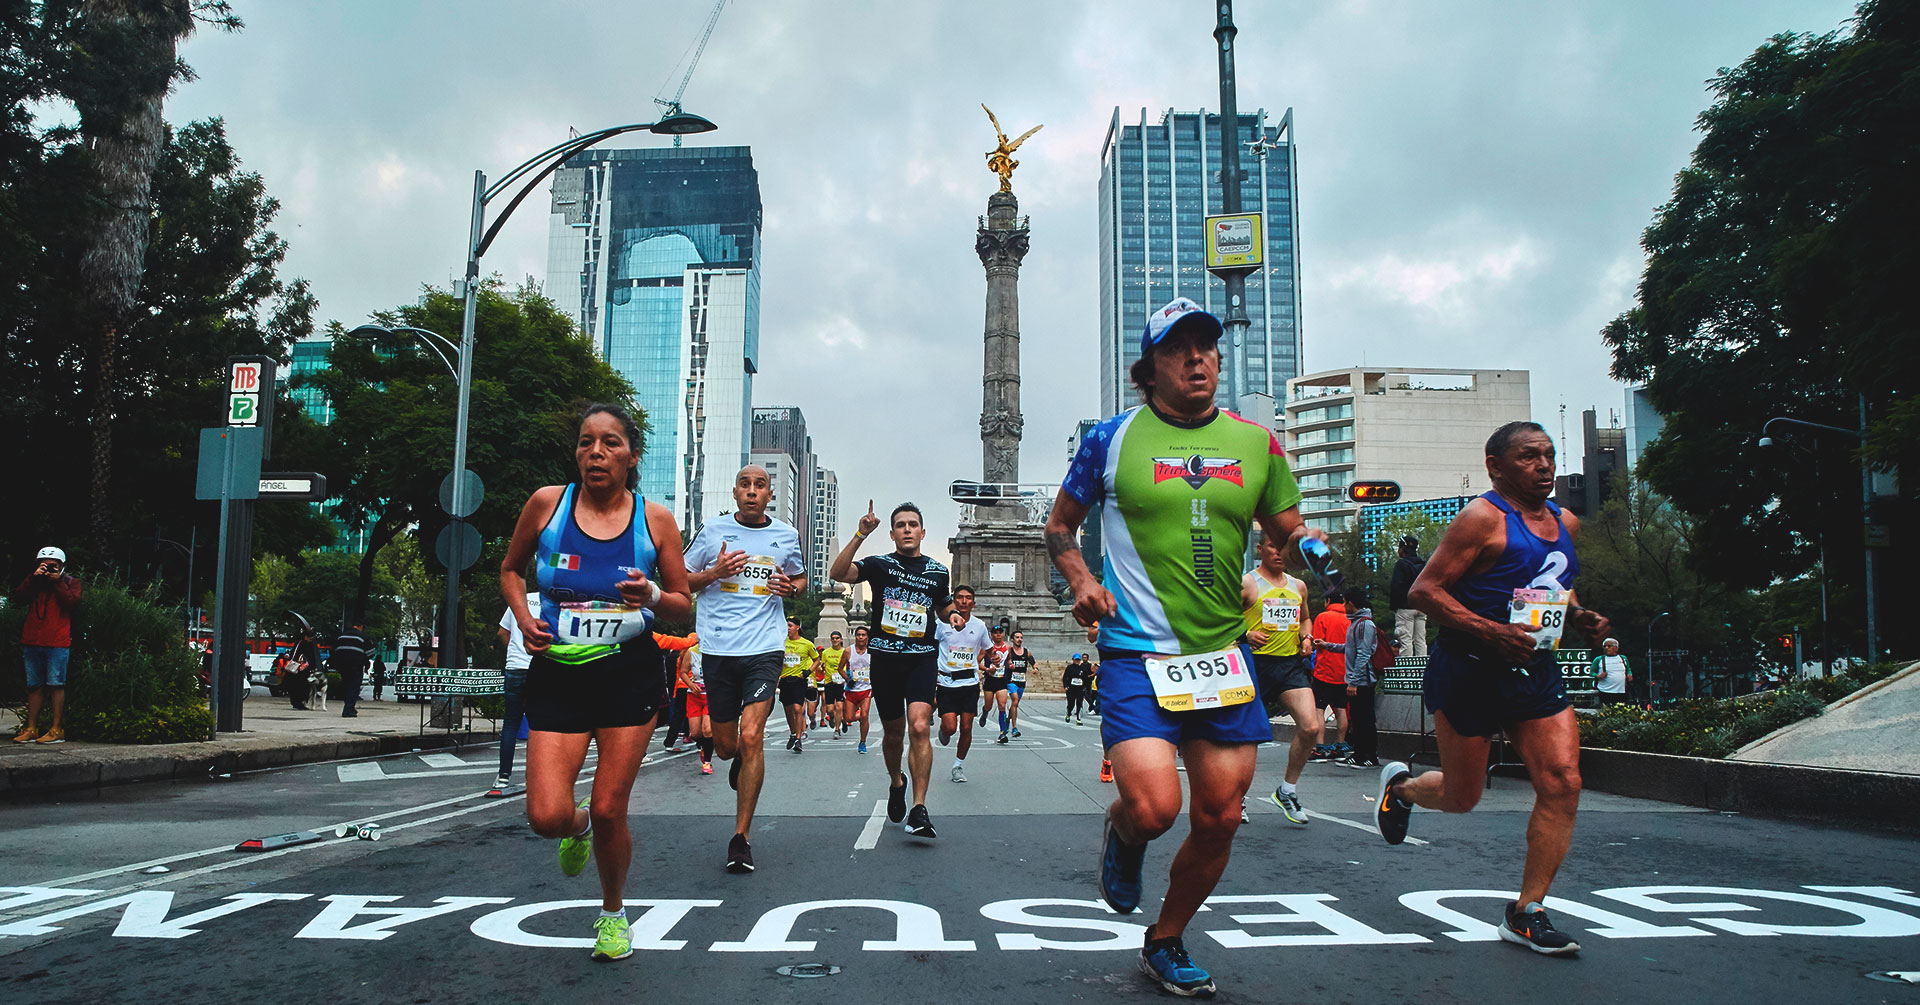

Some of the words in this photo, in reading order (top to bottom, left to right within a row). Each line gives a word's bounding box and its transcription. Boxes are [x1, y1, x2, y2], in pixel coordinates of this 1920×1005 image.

[235, 367, 256, 389] MB
[261, 480, 288, 489] ÁNGEL
[736, 566, 768, 580] 655
[889, 611, 922, 625] 11474
[1268, 608, 1297, 618] 14370
[1541, 610, 1562, 628] 68
[582, 619, 623, 637] 177
[1166, 657, 1229, 683] 6195
[1225, 690, 1249, 699] CDMX
